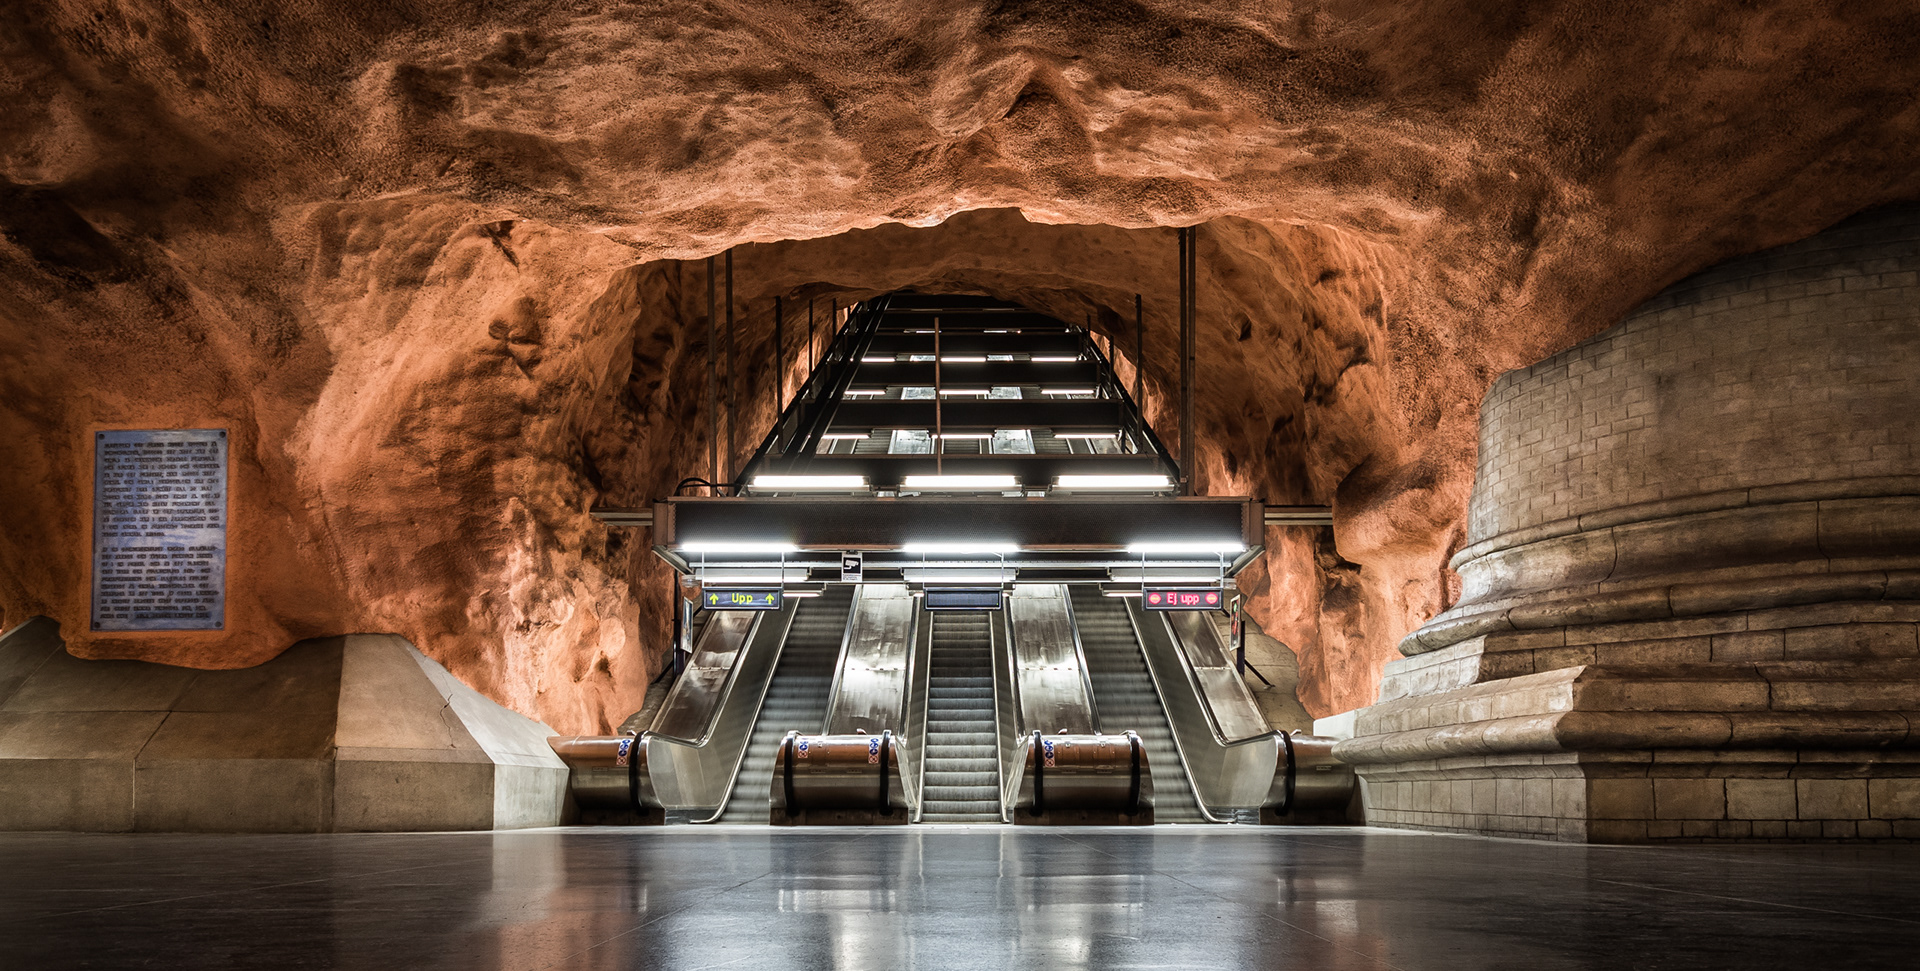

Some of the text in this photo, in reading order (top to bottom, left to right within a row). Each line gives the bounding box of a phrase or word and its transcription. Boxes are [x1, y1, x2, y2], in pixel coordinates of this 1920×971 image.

[731, 592, 753, 605] Upp
[1167, 592, 1200, 605] Ej upp
